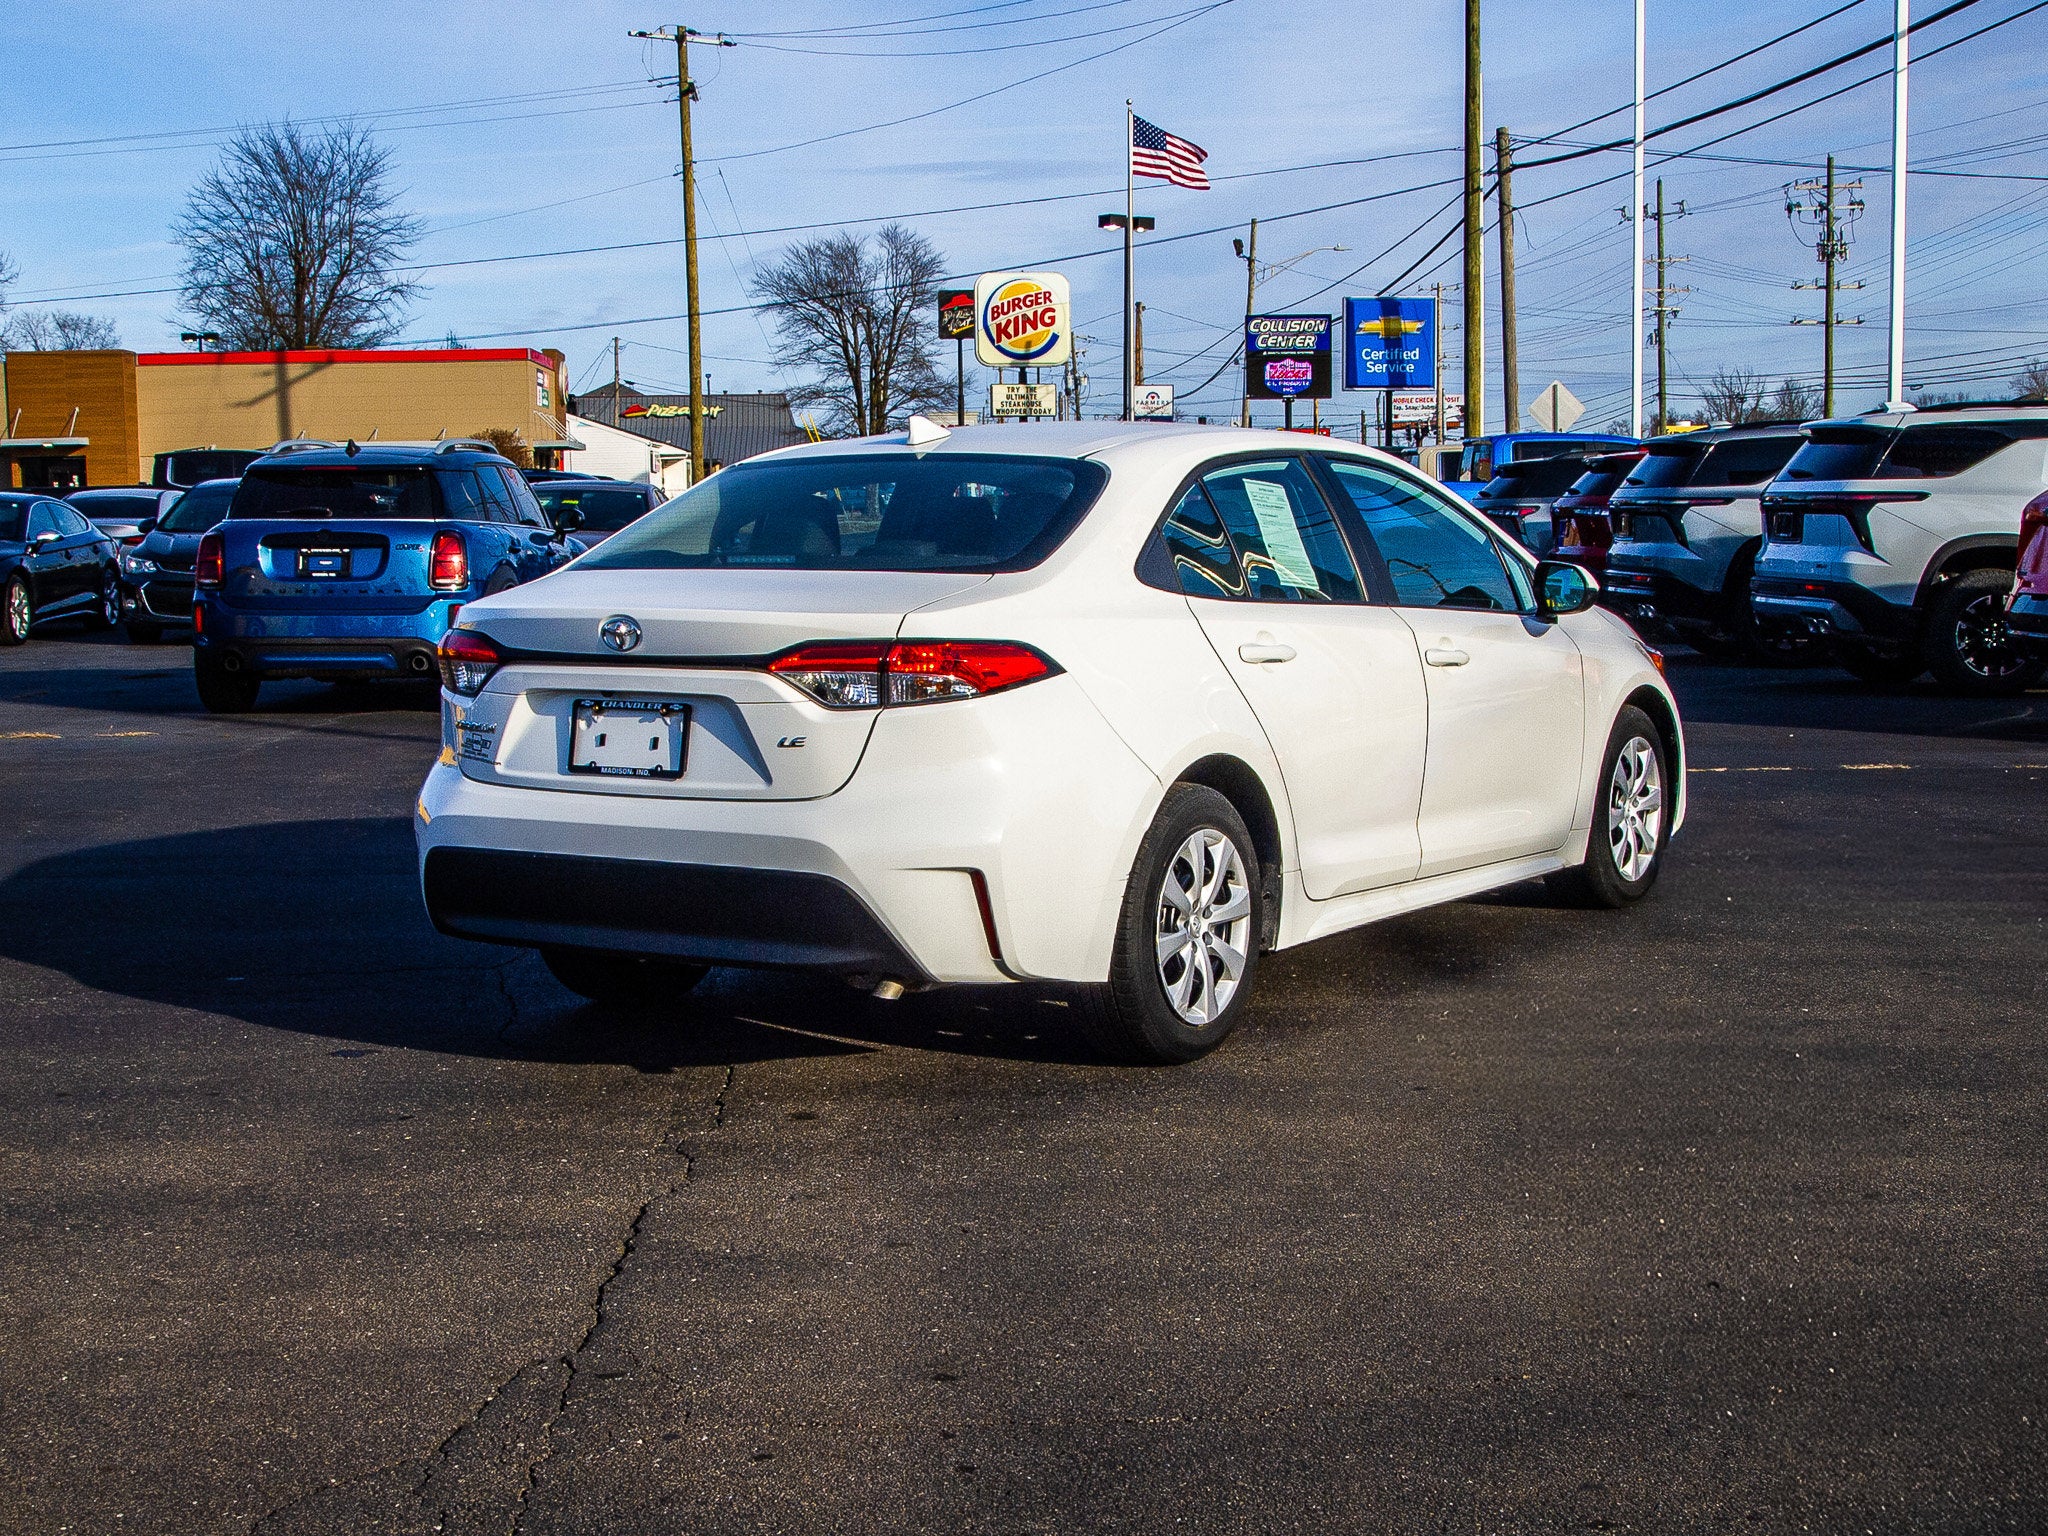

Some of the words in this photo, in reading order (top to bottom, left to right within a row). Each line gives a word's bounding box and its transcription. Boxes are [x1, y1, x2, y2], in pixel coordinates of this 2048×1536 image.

[990, 290, 1053, 322] BURGER
[995, 307, 1056, 344] KING
[1249, 318, 1327, 333] COLLISION
[1256, 333, 1317, 348] CENTER
[1361, 347, 1420, 360] Certified
[1366, 361, 1415, 373] Service
[1393, 396, 1414, 404] MOBILE
[646, 404, 691, 417] Pizza
[602, 701, 662, 709] CHANDLER
[777, 736, 807, 748] LE
